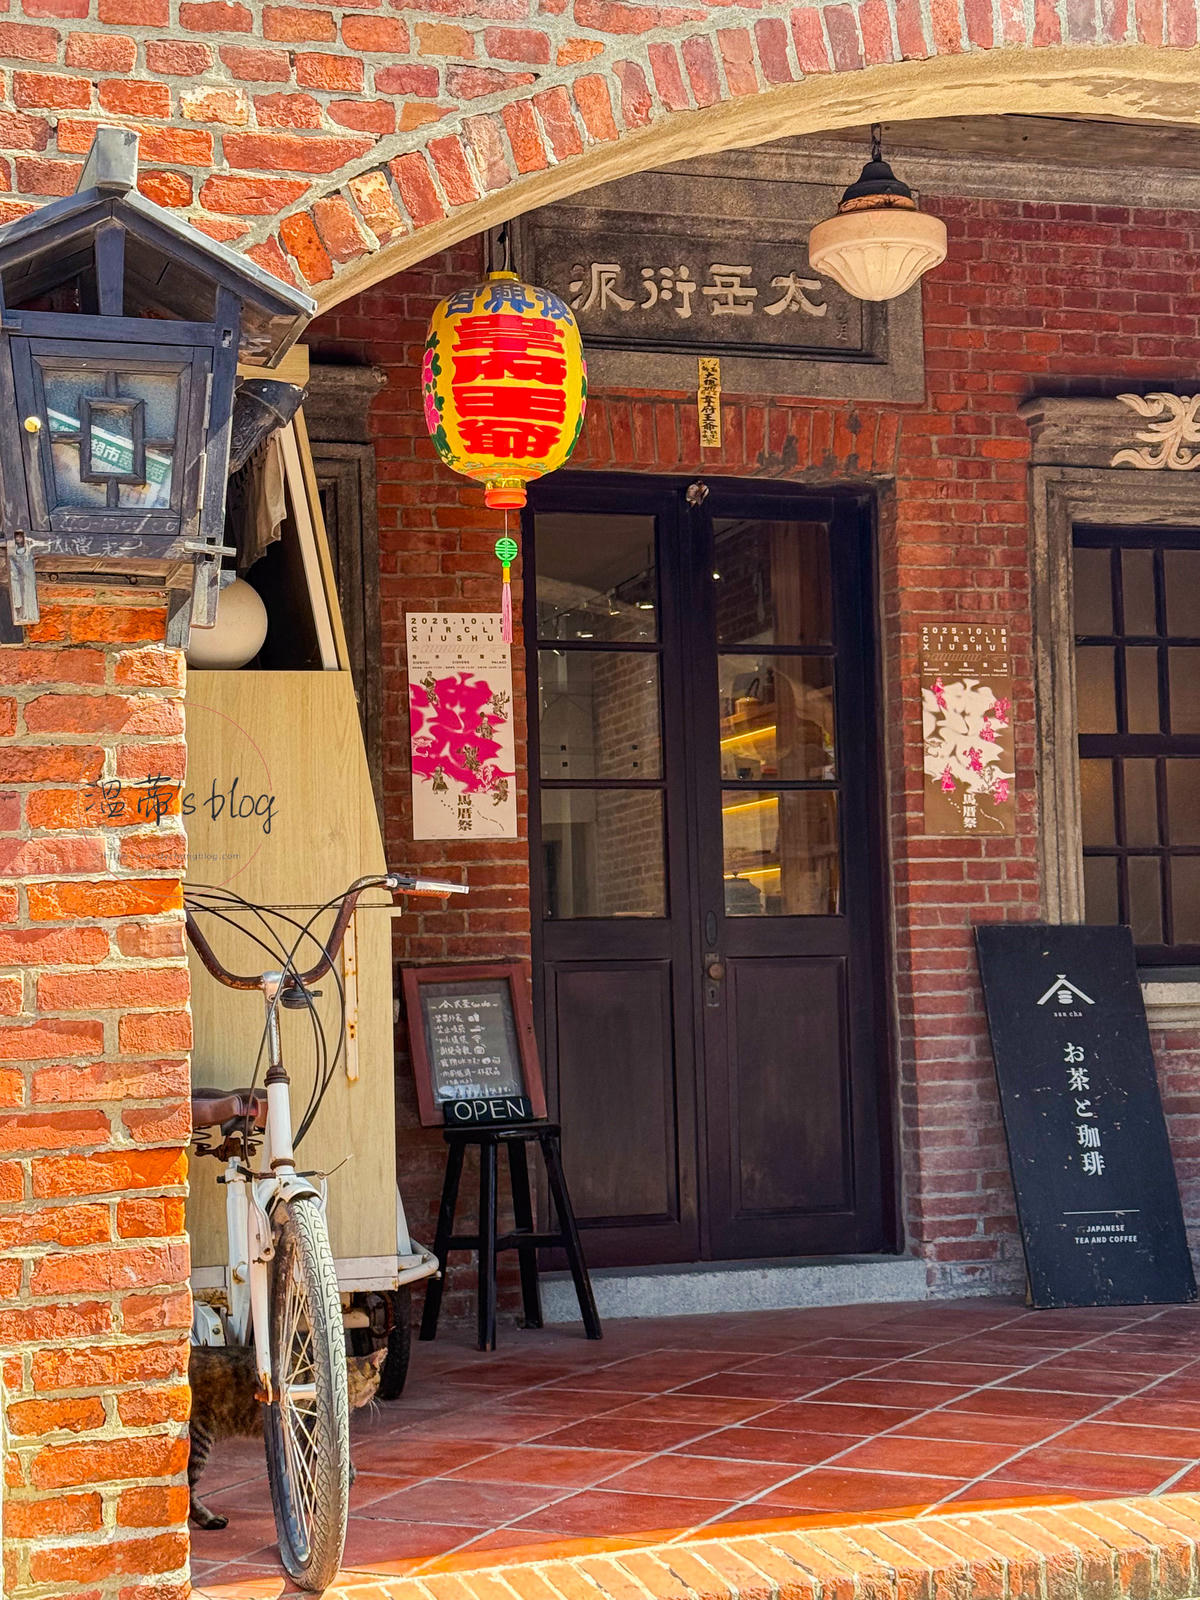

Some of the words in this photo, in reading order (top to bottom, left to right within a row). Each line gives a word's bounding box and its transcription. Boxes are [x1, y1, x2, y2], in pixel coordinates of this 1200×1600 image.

[922, 626, 1007, 636] 2025.10.18
[922, 635, 1007, 644] CIRCLE
[922, 643, 1008, 651] XIUSHUI
[454, 1098, 525, 1121] OPEN
[1063, 1042, 1106, 1176] お茶と珈琲
[1086, 1224, 1126, 1233] JAPANESE
[1074, 1236, 1090, 1245] TEA
[1091, 1236, 1107, 1244] AND
[1109, 1235, 1138, 1243] COFFEE
